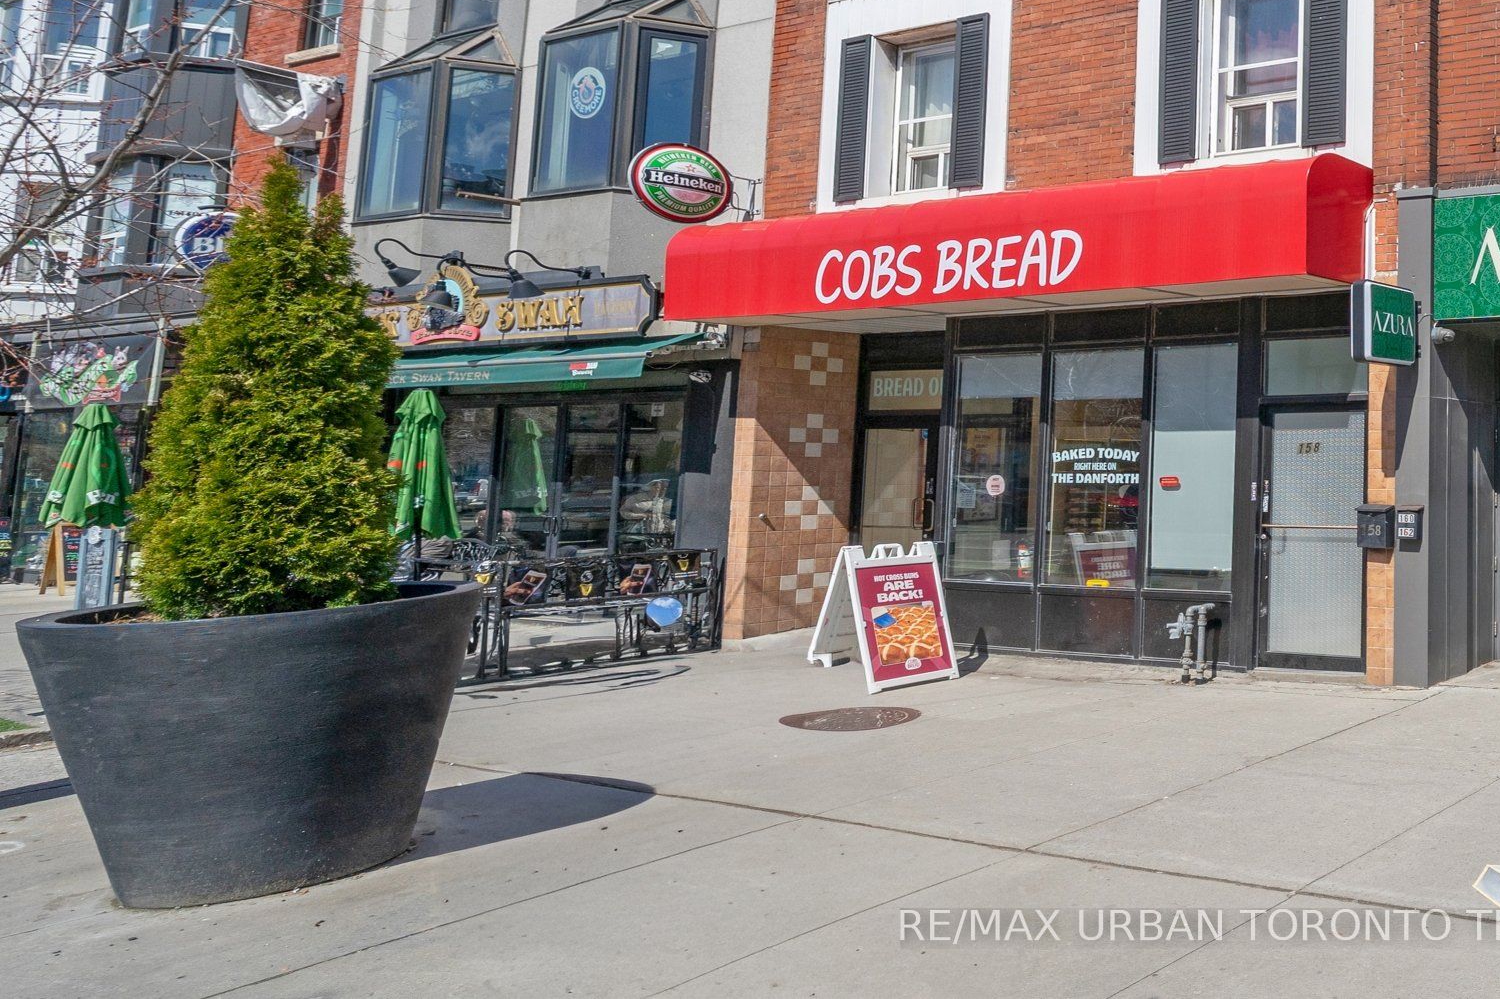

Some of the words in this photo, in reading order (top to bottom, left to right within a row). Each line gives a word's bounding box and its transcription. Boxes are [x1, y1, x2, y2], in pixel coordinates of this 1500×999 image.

[658, 151, 697, 165] HEINEKEN
[699, 156, 717, 174] BEER
[649, 170, 723, 193] Heineken
[654, 190, 687, 212] PREMIUM
[688, 200, 716, 212] QUALITY
[814, 244, 922, 304] COBS
[932, 229, 1083, 295] BREAD
[495, 295, 584, 333] SWAN
[1373, 310, 1414, 337] AZURA
[411, 372, 442, 383] SWAN
[447, 370, 491, 382] TAVERN
[873, 377, 924, 397] BREAD
[1052, 447, 1096, 462] BAKED
[1097, 447, 1140, 462] TODAY
[1298, 442, 1321, 454] 158
[1073, 462, 1091, 471] RIGHT
[1091, 462, 1107, 471] HERE
[1107, 462, 1117, 471] ON
[1051, 473, 1074, 484] THE
[1075, 473, 1140, 484] DANFORTH
[1361, 524, 1382, 536] 158
[1399, 528, 1414, 538] 162
[873, 574, 886, 583] HOT
[886, 573, 904, 582] CROSS
[903, 571, 920, 579] BUNS
[883, 579, 915, 592] ARE
[876, 589, 924, 603] BACK!
